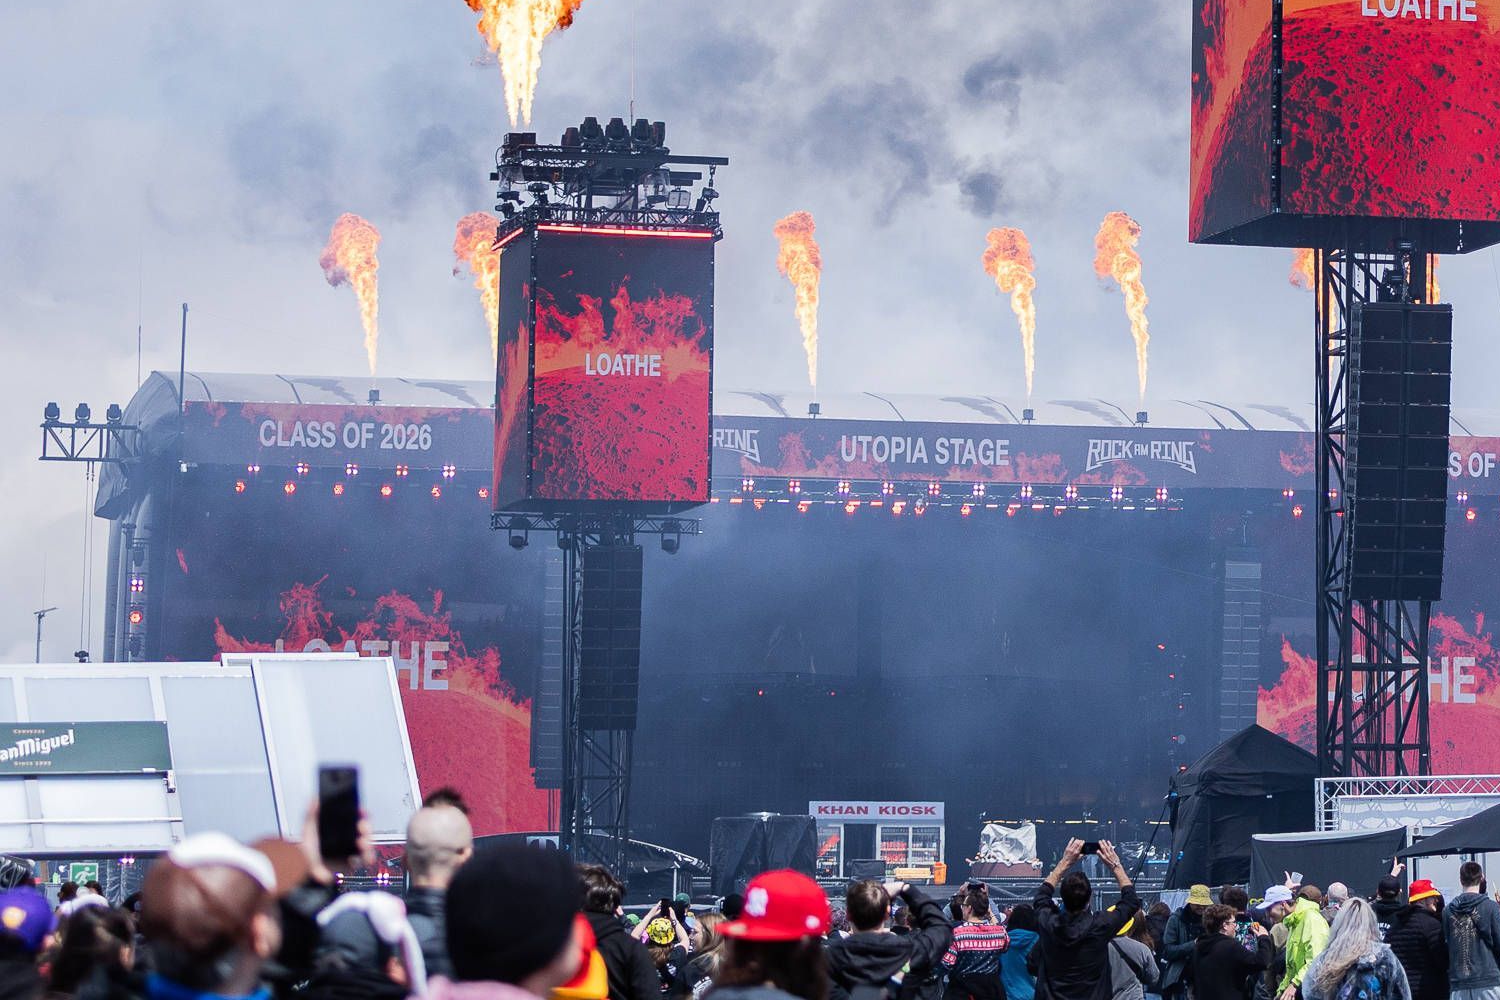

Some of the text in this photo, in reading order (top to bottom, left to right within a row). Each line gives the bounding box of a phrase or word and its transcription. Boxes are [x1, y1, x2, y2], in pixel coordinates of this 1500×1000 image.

[585, 353, 661, 377] LOATHE
[259, 420, 432, 450] CLASS OF 2026
[712, 428, 761, 463] RING
[841, 435, 1010, 466] UTOPIA STAGE
[1086, 439, 1197, 474] ROCK AM RING
[1468, 452, 1496, 477] OF
[0, 729, 75, 762] anMiguel
[818, 805, 937, 816] KHAN KIOSK
